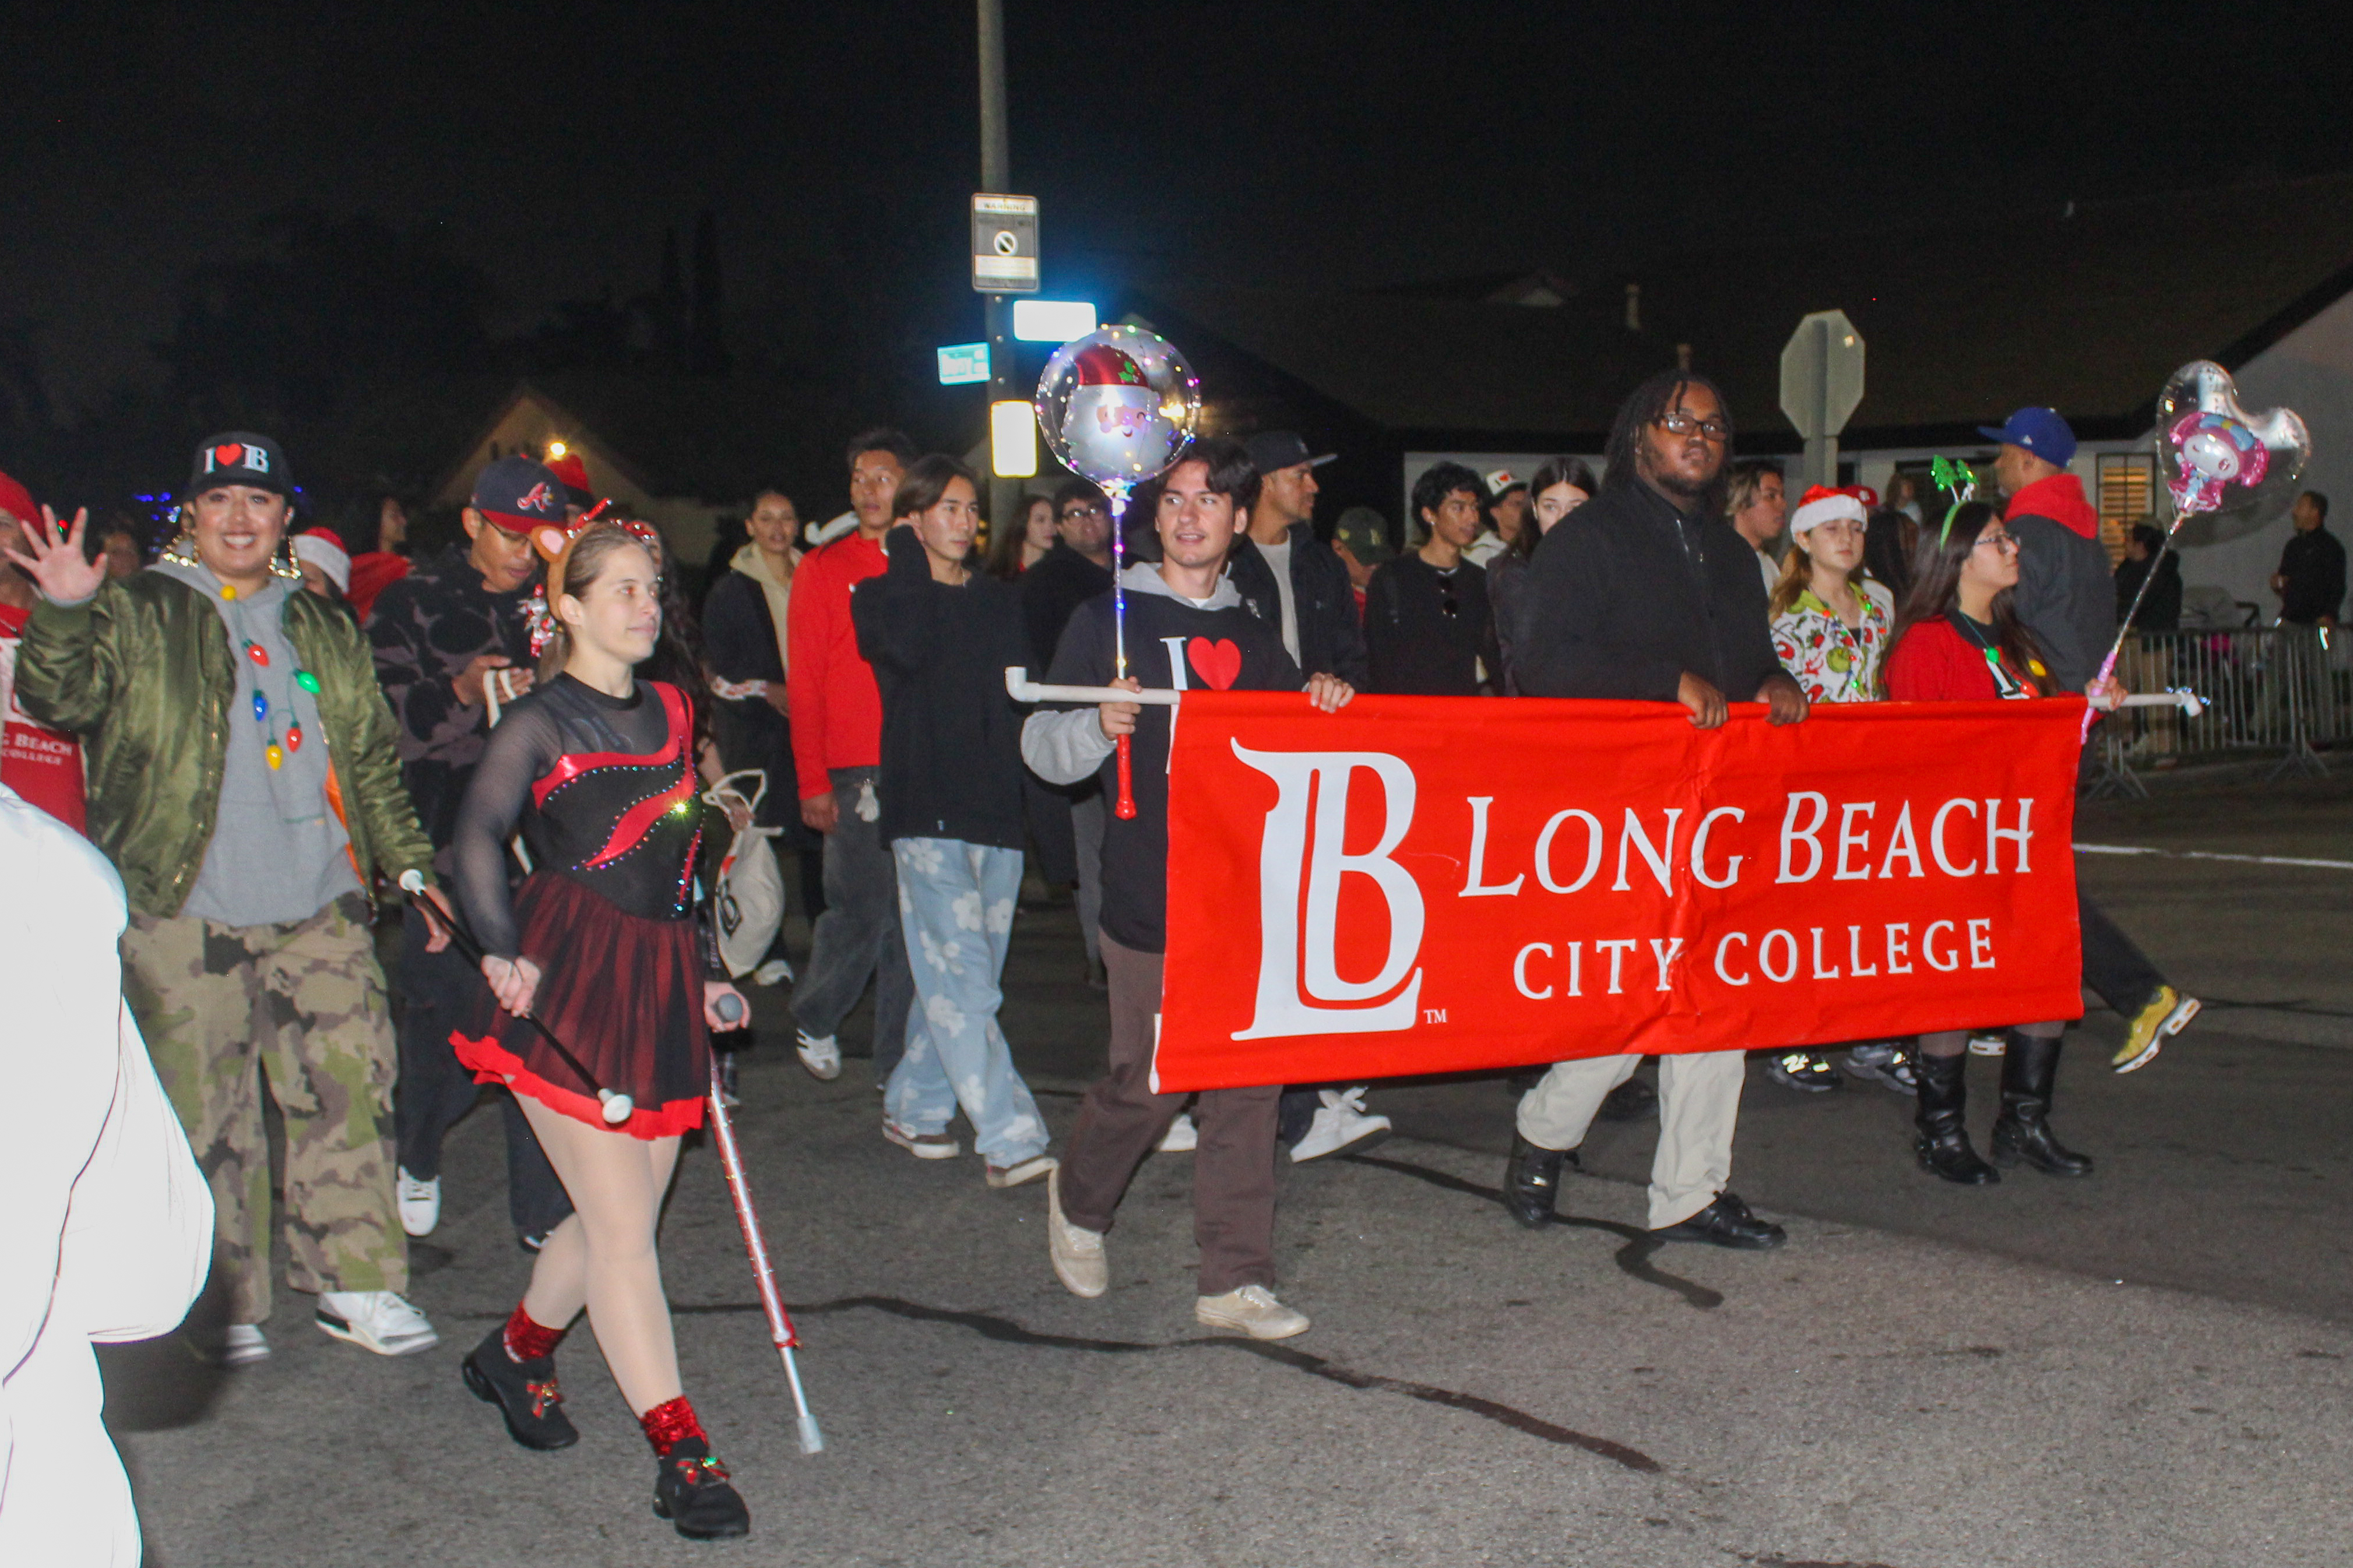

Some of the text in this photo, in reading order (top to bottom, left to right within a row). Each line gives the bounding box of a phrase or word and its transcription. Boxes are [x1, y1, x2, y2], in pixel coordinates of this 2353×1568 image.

[204, 446, 215, 474] I
[15, 733, 72, 756] BEACH
[1458, 790, 2034, 898] LONG BEACH
[1513, 918, 1996, 1000] CITY COLLEGE
